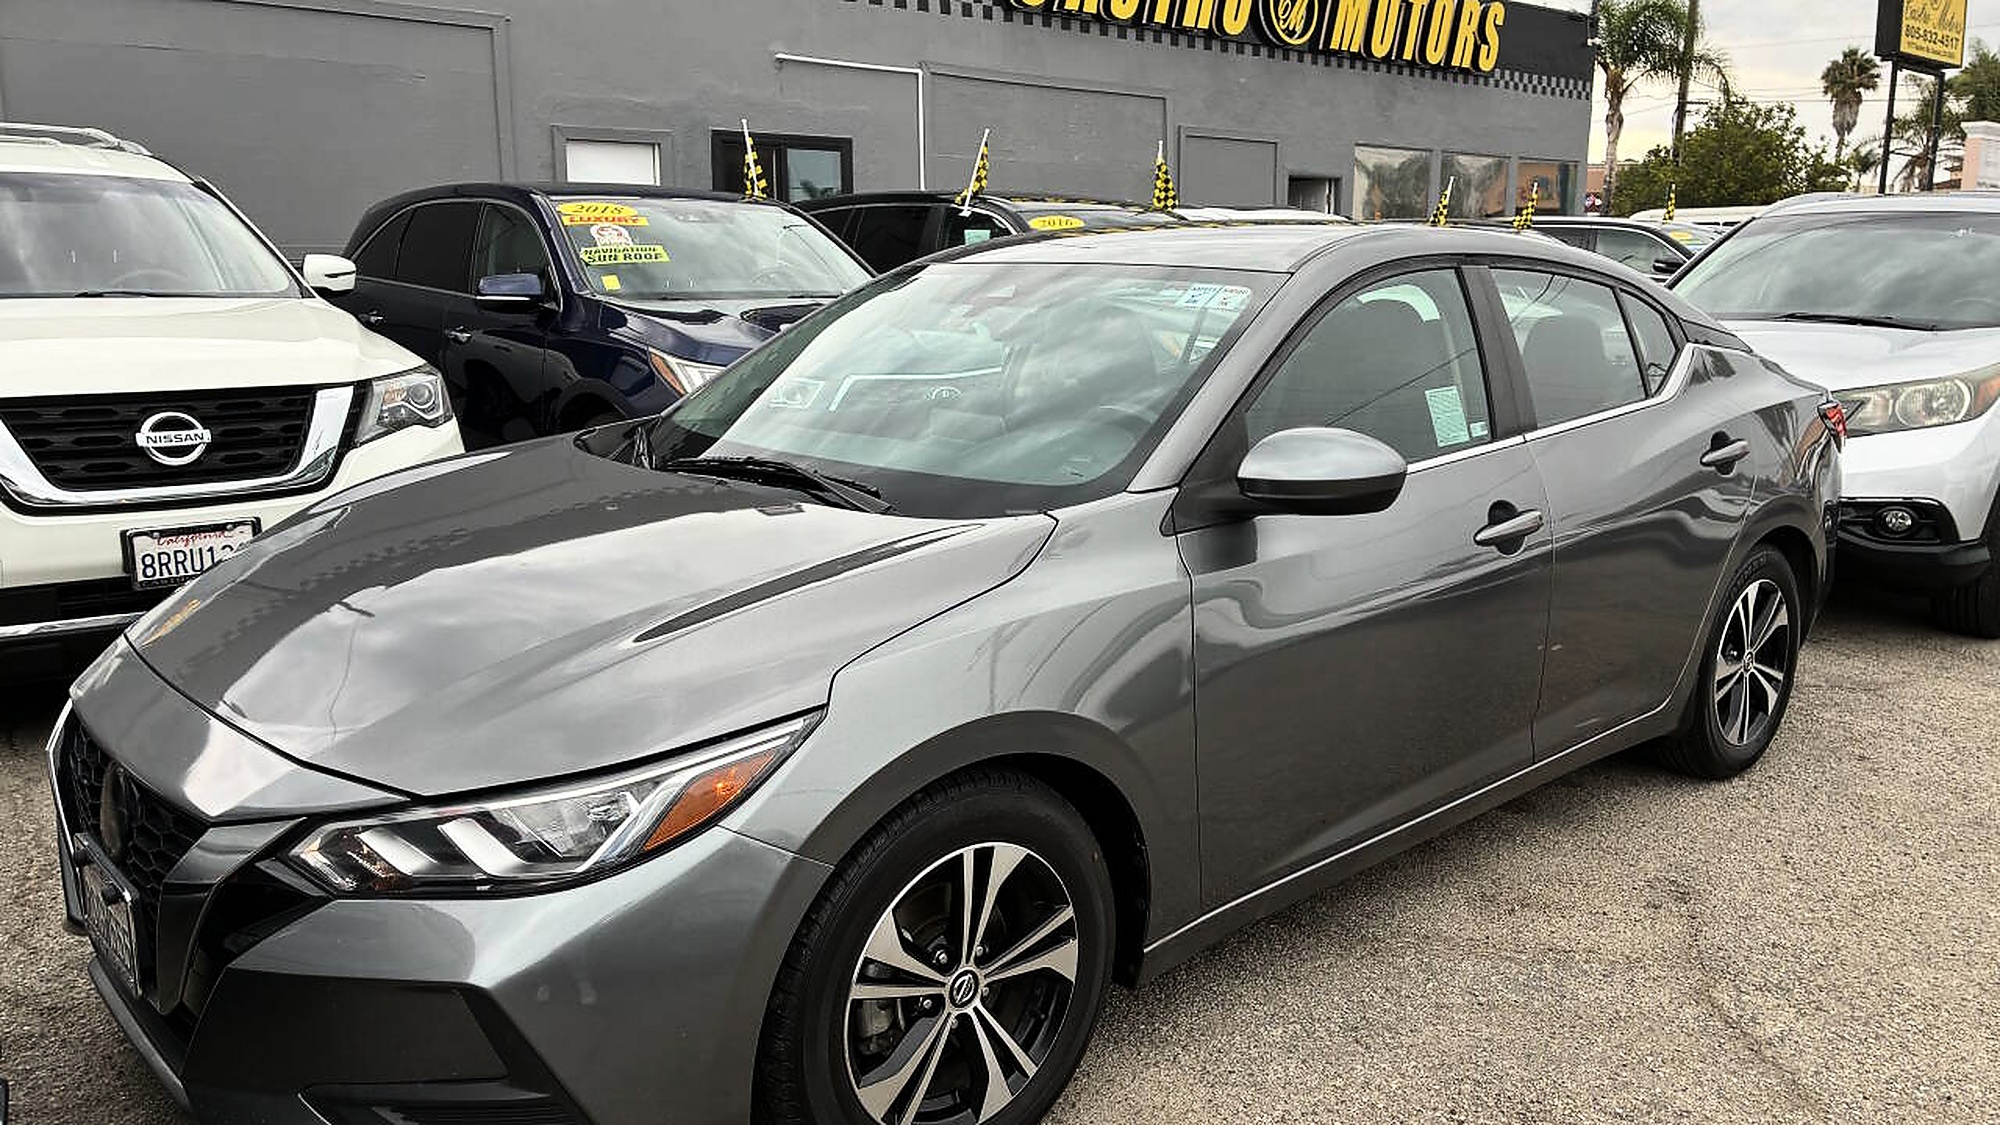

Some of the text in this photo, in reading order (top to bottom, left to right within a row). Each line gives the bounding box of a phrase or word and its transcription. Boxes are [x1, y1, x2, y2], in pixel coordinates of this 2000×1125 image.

[1329, 0, 1505, 72] MOTORS
[572, 204, 625, 215] 2018
[583, 246, 659, 256] NAVIGATION
[587, 252, 663, 262] SUN ROOF
[145, 431, 205, 445] NISSAN
[156, 530, 230, 548] California
